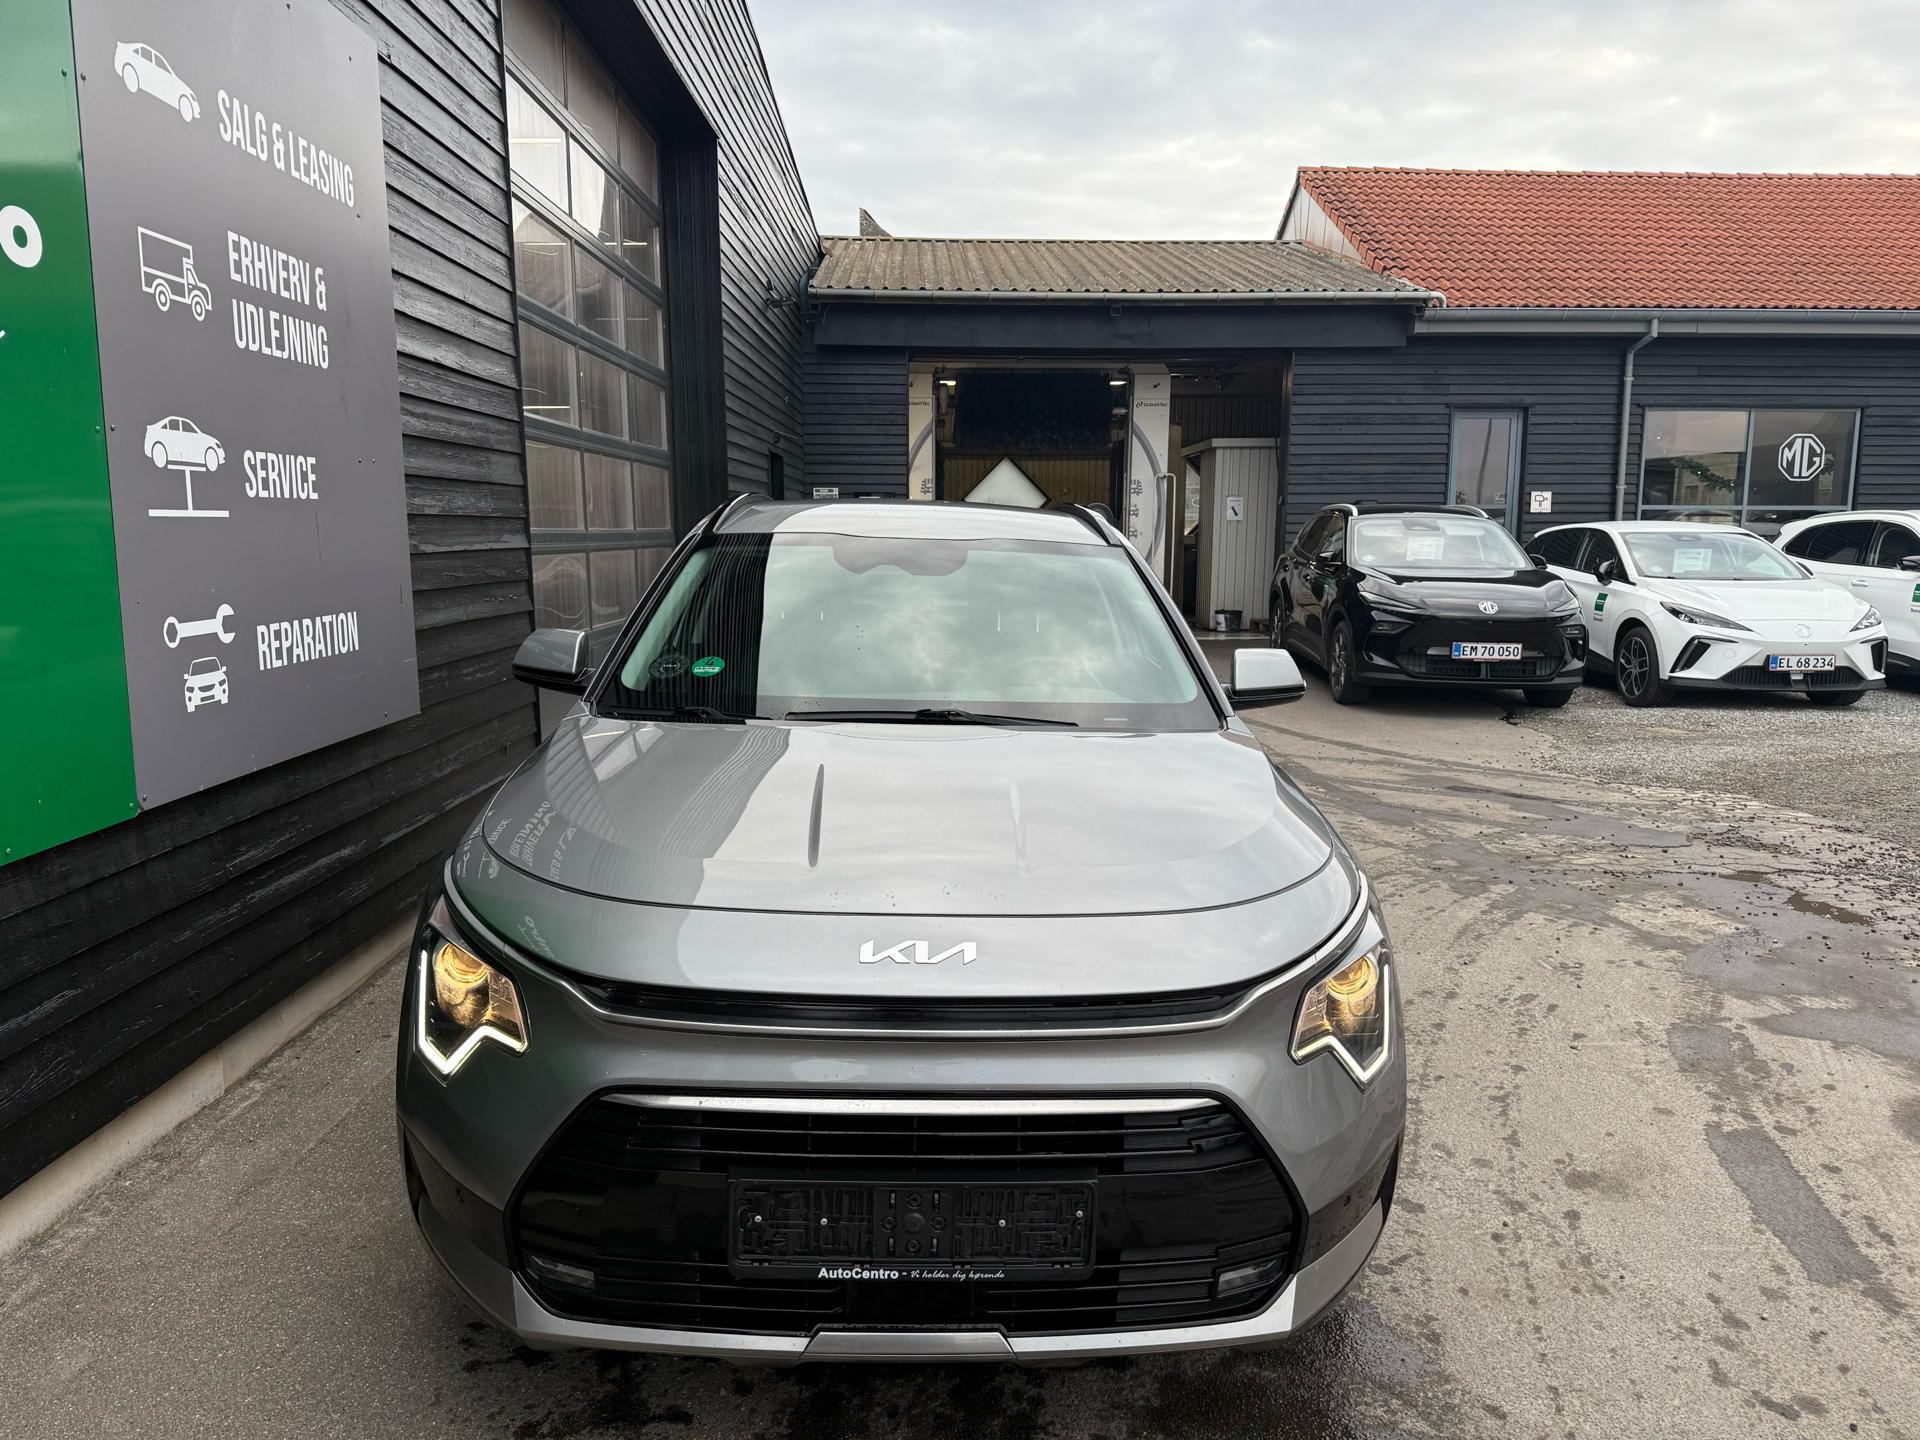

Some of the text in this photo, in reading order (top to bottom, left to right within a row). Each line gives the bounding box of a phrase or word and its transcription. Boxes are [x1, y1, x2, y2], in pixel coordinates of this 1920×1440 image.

[217, 89, 355, 208] SALG & LEASING
[227, 230, 327, 311] ERHVERV &
[232, 298, 329, 370] UDLEJNING
[1782, 438, 1821, 477] MG
[243, 450, 319, 500] SERVICE
[1478, 600, 1499, 615] MG
[256, 611, 360, 671] REPARATION
[1462, 646, 1478, 657] EM
[1481, 646, 1495, 657] 70
[1498, 646, 1520, 657] 050
[705, 657, 715, 667] 4
[1778, 657, 1793, 669] EL
[1796, 657, 1811, 669] 68
[1812, 657, 1834, 669] 234
[859, 939, 977, 965] KIA
[818, 1268, 899, 1279] AutoCentro
[910, 1270, 920, 1279] Vi
[922, 1270, 950, 1279] holder
[952, 1270, 966, 1282] dig
[969, 1270, 1005, 1280] kørende
